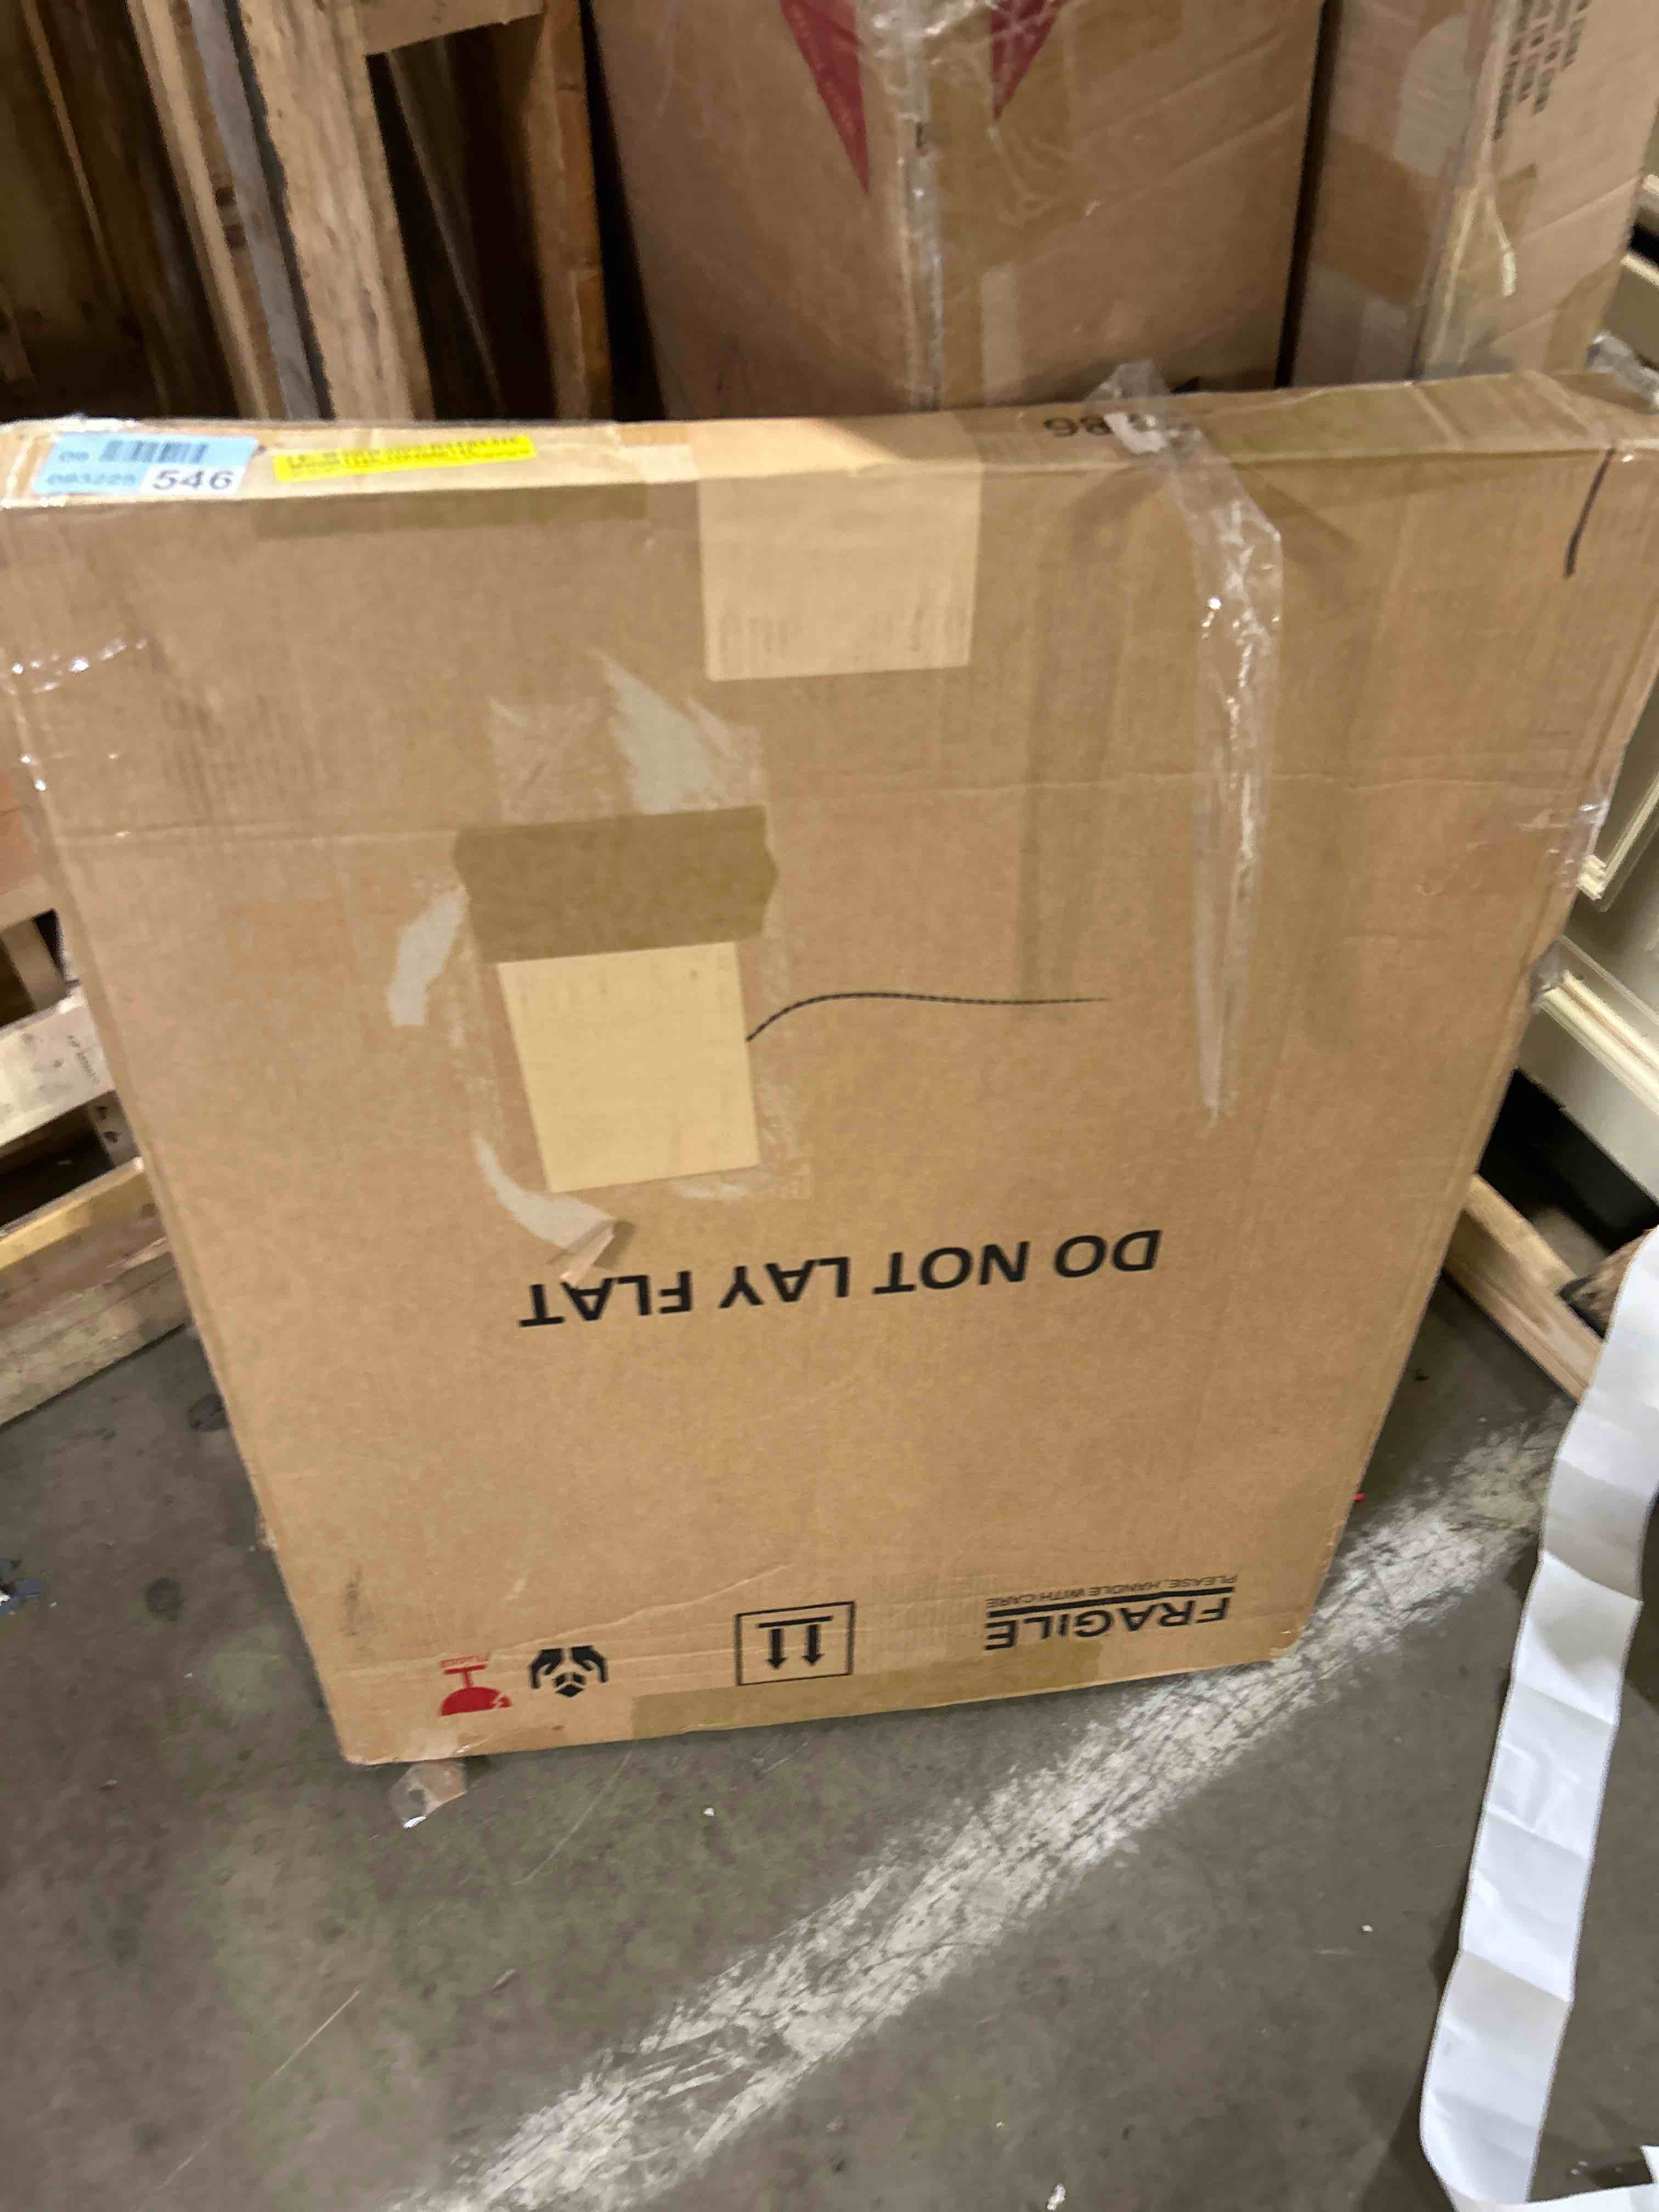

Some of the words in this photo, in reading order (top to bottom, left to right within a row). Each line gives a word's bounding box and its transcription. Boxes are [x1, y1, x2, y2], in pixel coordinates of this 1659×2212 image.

[153, 469, 234, 491] 546
[873, 1242, 1031, 1295] NOT
[1054, 1229, 1162, 1278] DO
[518, 1271, 693, 1328] FLAT
[719, 1256, 850, 1308] LAY
[986, 1594, 1036, 1608] CARE
[1040, 1588, 1085, 1602] WITH
[1088, 1581, 1160, 1596] HANDLE
[984, 1597, 1230, 1650] FRAGILE
